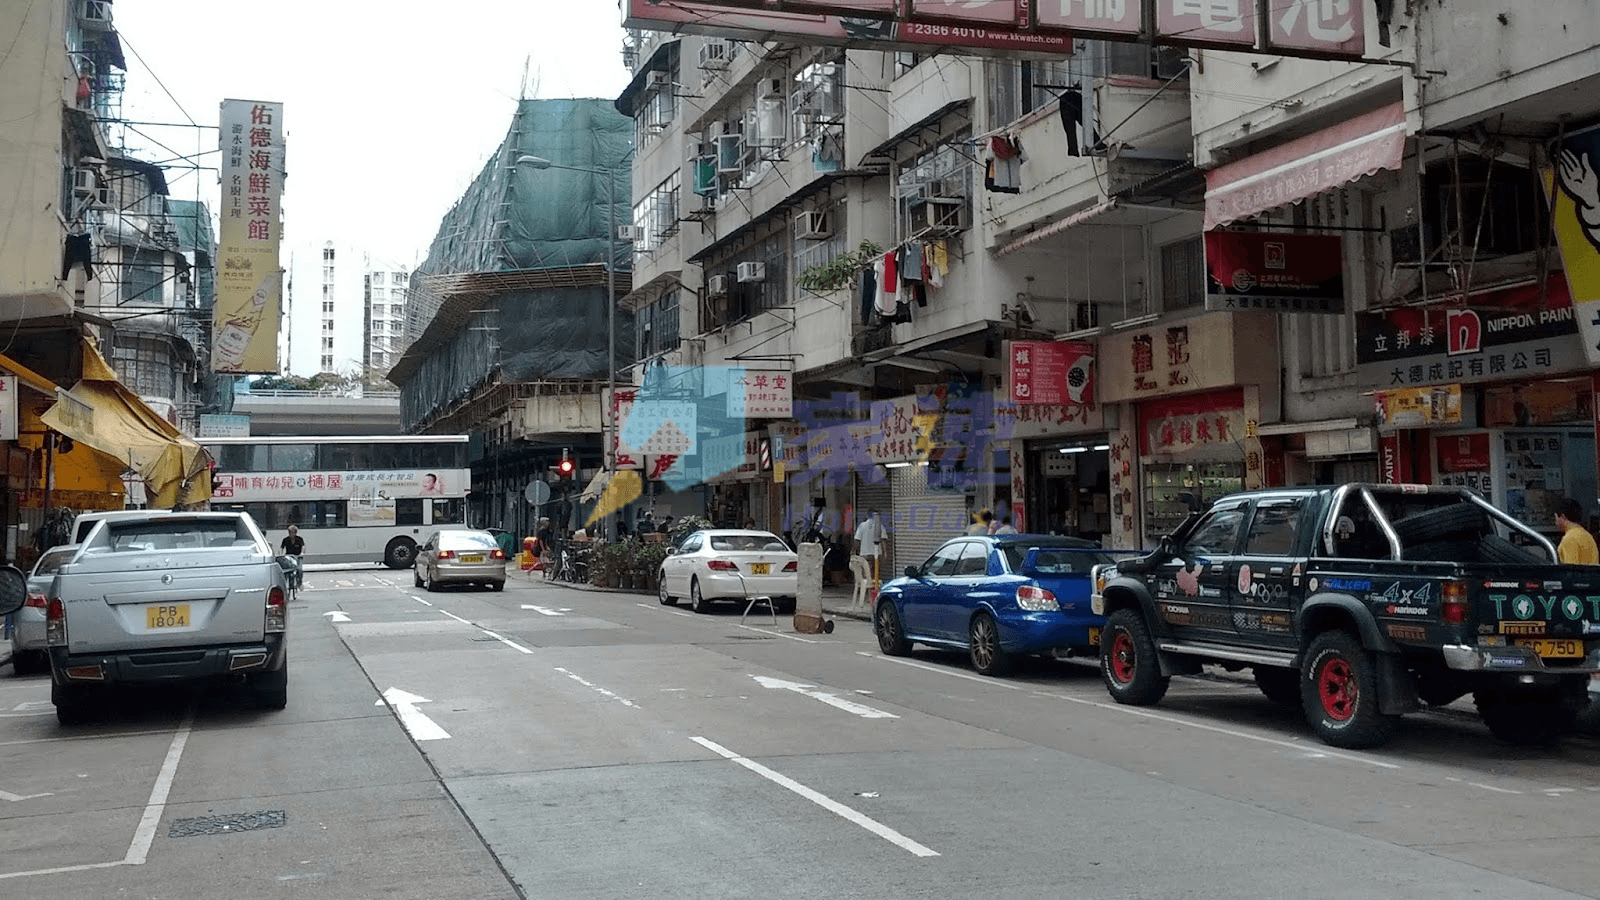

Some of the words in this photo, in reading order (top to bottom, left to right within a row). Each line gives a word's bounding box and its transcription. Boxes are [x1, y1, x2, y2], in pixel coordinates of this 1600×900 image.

[914, 23, 948, 36] 2386
[951, 27, 984, 40] 4010
[987, 32, 1063, 45] www.kkwatch.com
[230, 123, 243, 168] 游水海鮮
[248, 104, 273, 241] 佑德海鮮菜館
[1487, 313, 1535, 333] NIPPON
[1375, 327, 1435, 353] 立邦漆
[1390, 347, 1551, 385] 大德成記有限公司
[1384, 581, 1431, 605] 4x4
[152, 616, 184, 628] 1804
[159, 606, 177, 617] PB
[1546, 641, 1576, 655] 750
